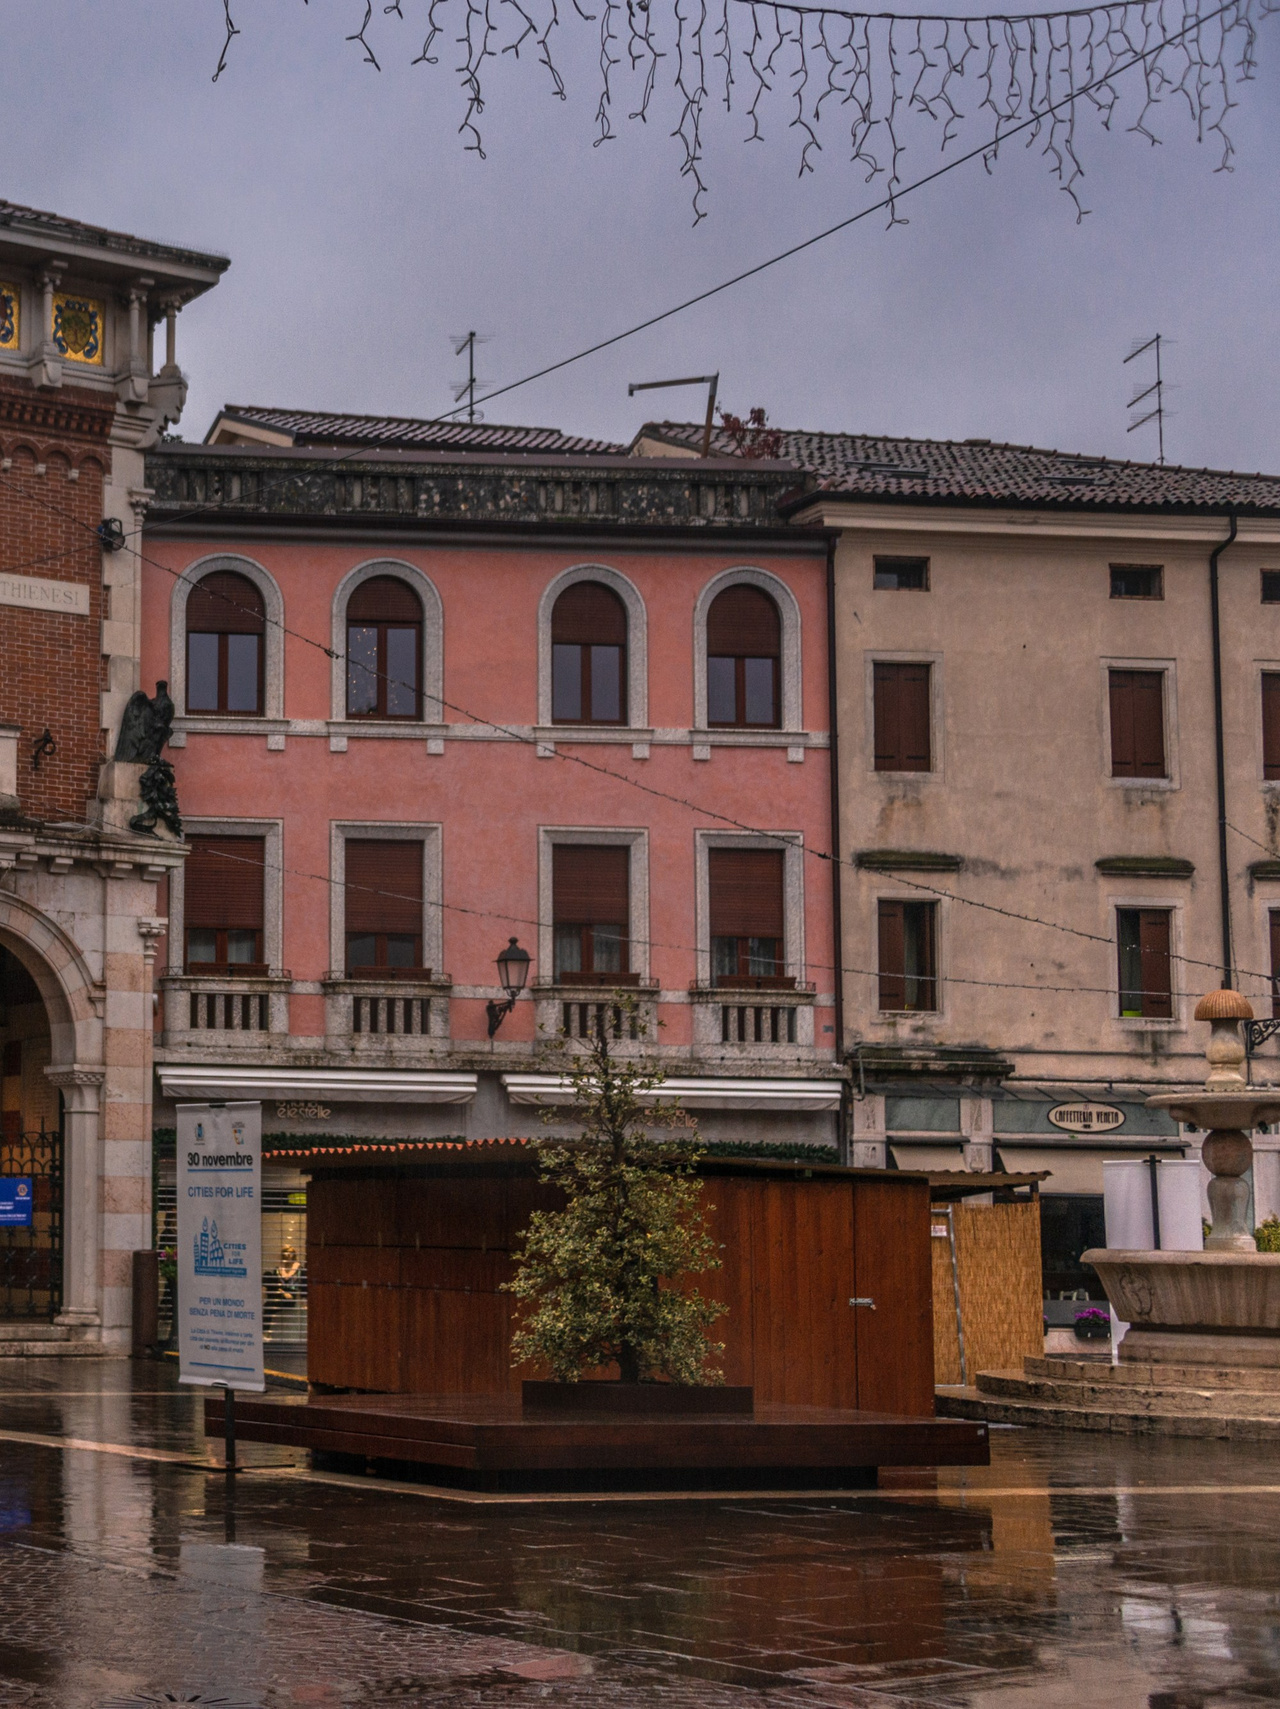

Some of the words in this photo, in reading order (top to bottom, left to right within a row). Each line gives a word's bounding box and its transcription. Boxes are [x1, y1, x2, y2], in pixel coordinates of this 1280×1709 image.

[0, 581, 79, 606] THIENESI
[1054, 1110, 1093, 1123] CAFFETTERIA
[1095, 1111, 1119, 1124] VENETA
[187, 1152, 200, 1166] 30
[202, 1151, 253, 1166] novembre
[188, 1186, 213, 1198] CITIES
[215, 1186, 233, 1198] FOR
[236, 1186, 254, 1198] LIFE
[199, 1296, 211, 1305] PER
[213, 1297, 221, 1306] UN
[223, 1298, 245, 1308] MONDO
[189, 1307, 208, 1317] SENZA
[210, 1308, 226, 1318] PENA
[227, 1310, 233, 1318] DI
[234, 1311, 256, 1320] MORTE
